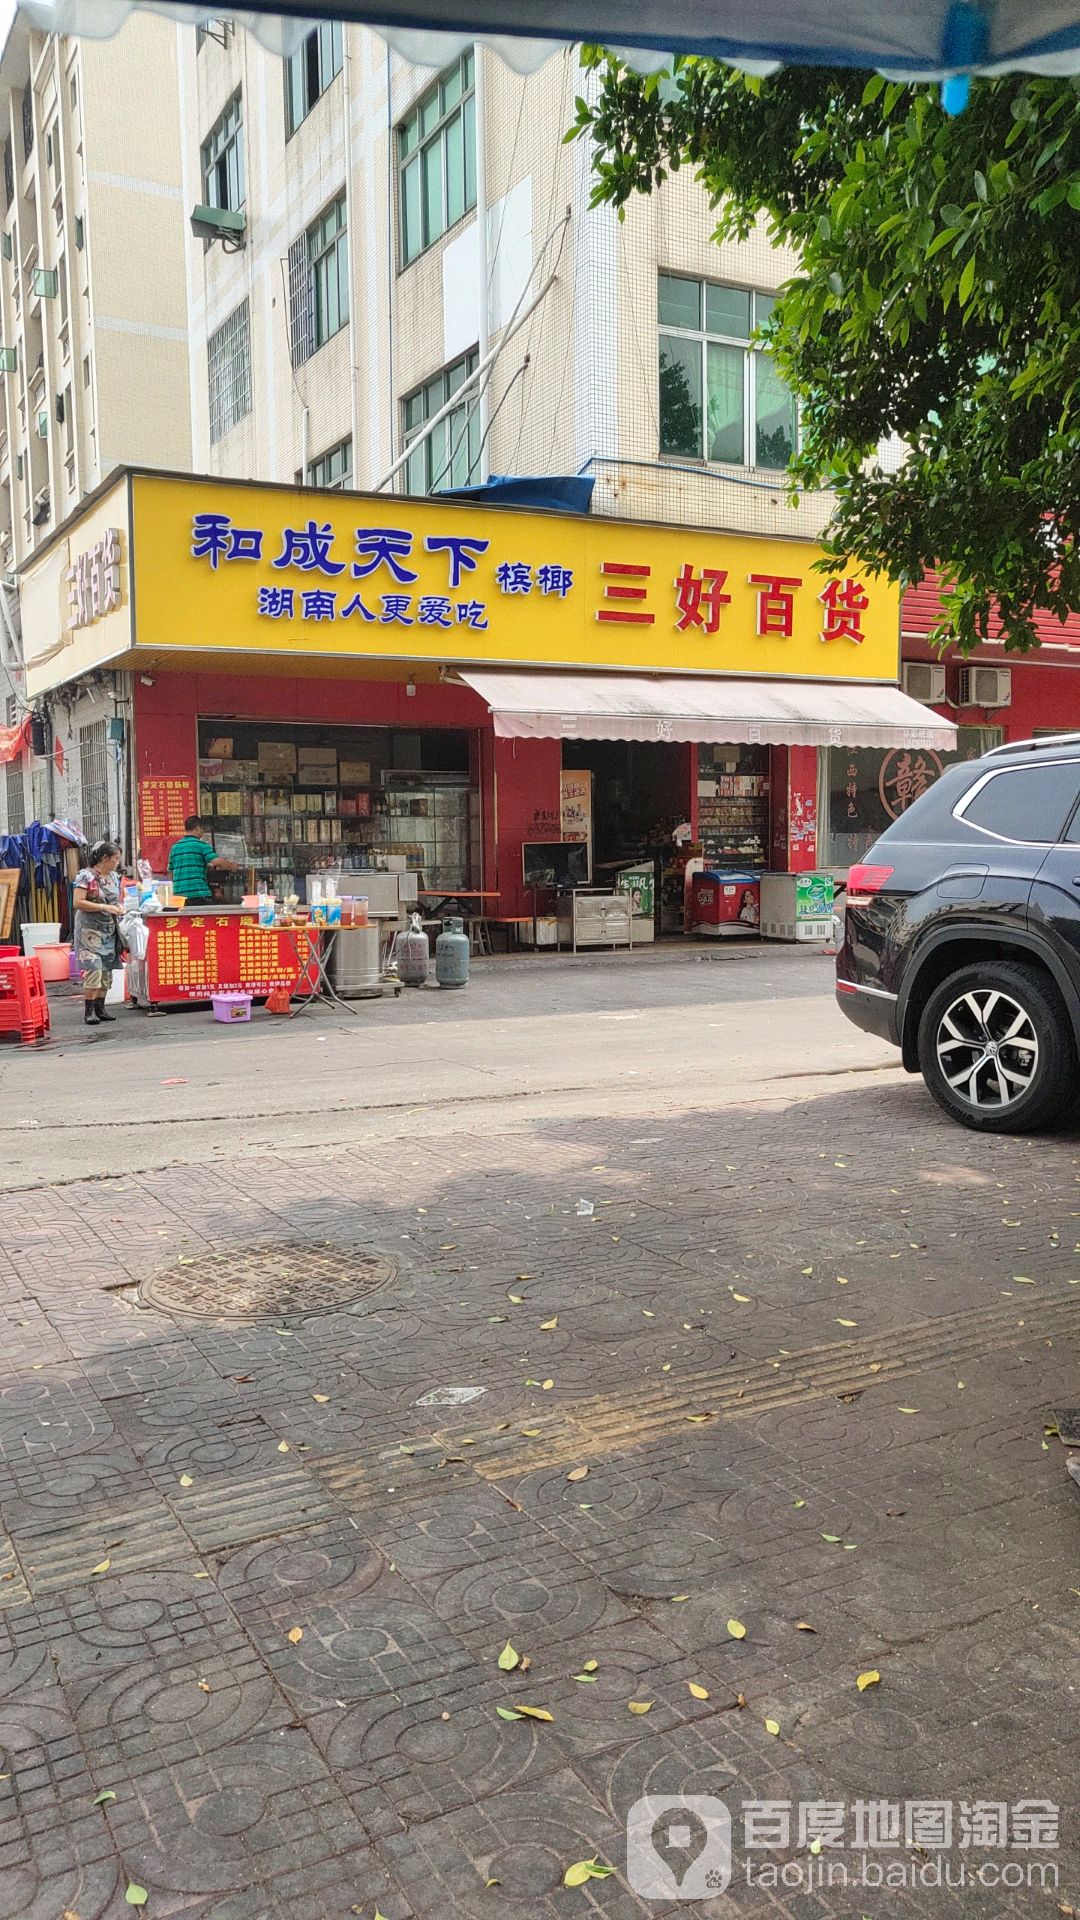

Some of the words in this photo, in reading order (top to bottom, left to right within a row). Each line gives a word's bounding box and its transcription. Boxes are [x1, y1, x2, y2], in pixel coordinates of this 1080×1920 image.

[190, 512, 491, 587] 和成天下
[495, 561, 575, 598] 槟榔
[257, 586, 490, 631] 湖南人更爱吃
[595, 561, 870, 645] 三好百货
[166, 916, 254, 928] 罗定石磨
